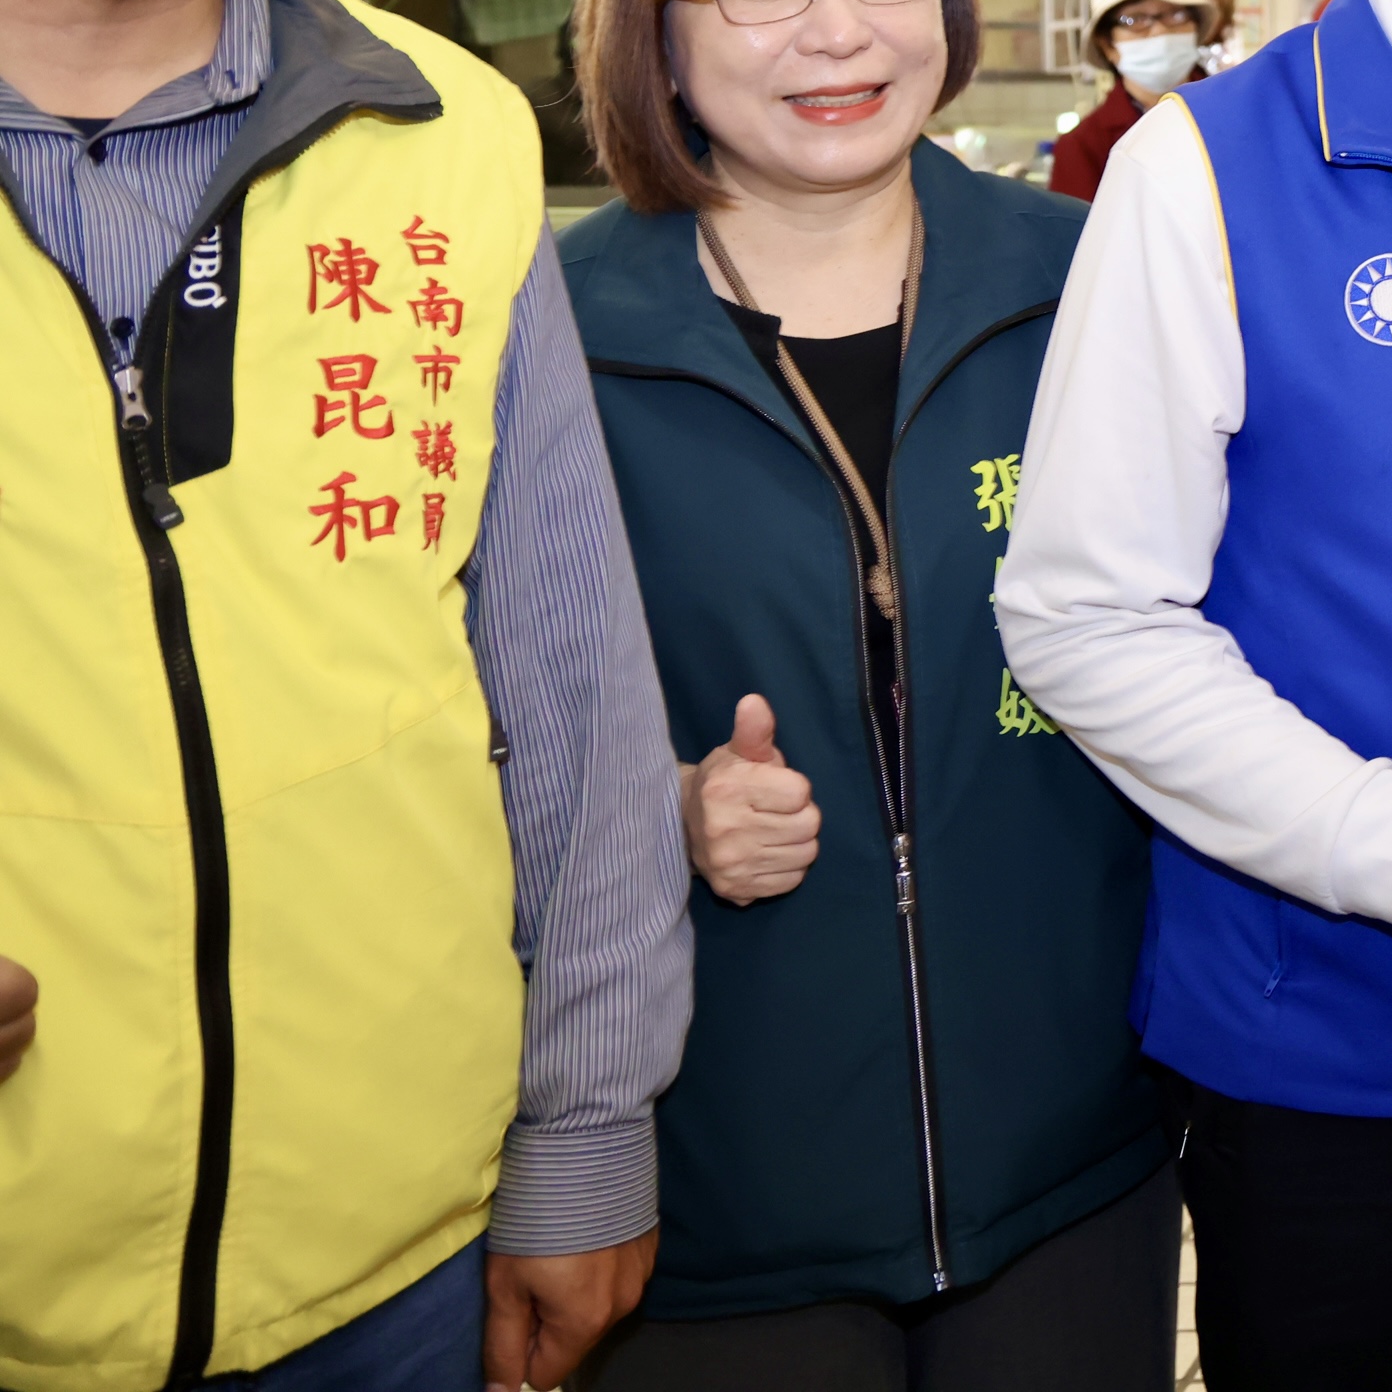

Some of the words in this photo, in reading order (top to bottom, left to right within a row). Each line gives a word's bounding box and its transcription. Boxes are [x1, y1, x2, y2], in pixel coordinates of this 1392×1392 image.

[306, 237, 400, 563] 陳昆和
[400, 215, 464, 555] 台南市議員
